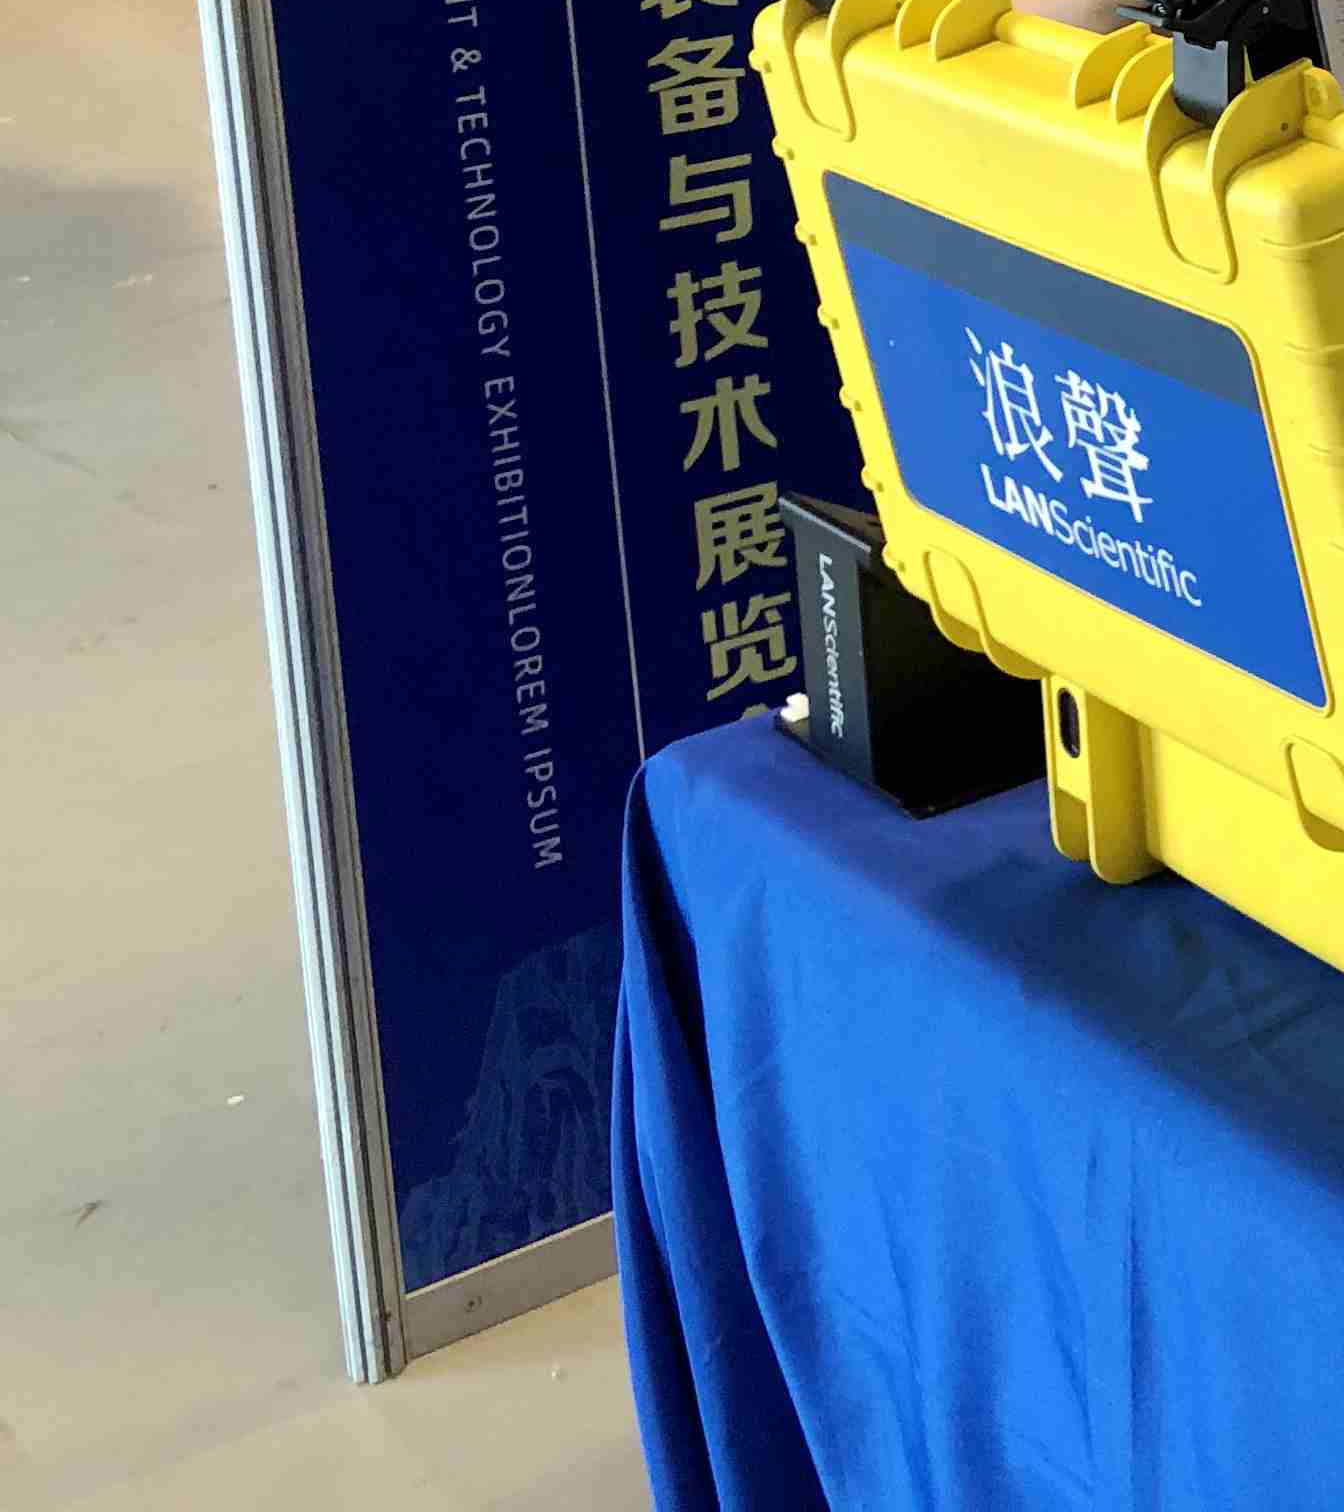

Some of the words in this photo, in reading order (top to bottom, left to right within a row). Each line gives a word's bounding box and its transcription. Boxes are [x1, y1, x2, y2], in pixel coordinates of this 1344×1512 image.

[450, 46, 482, 74] &
[455, 85, 510, 357] TECHNOLOGY
[964, 325, 1154, 523] 浪聲
[979, 462, 1203, 609] LANScientific
[817, 552, 847, 740] LANScientific
[524, 748, 562, 869] IPSUM
